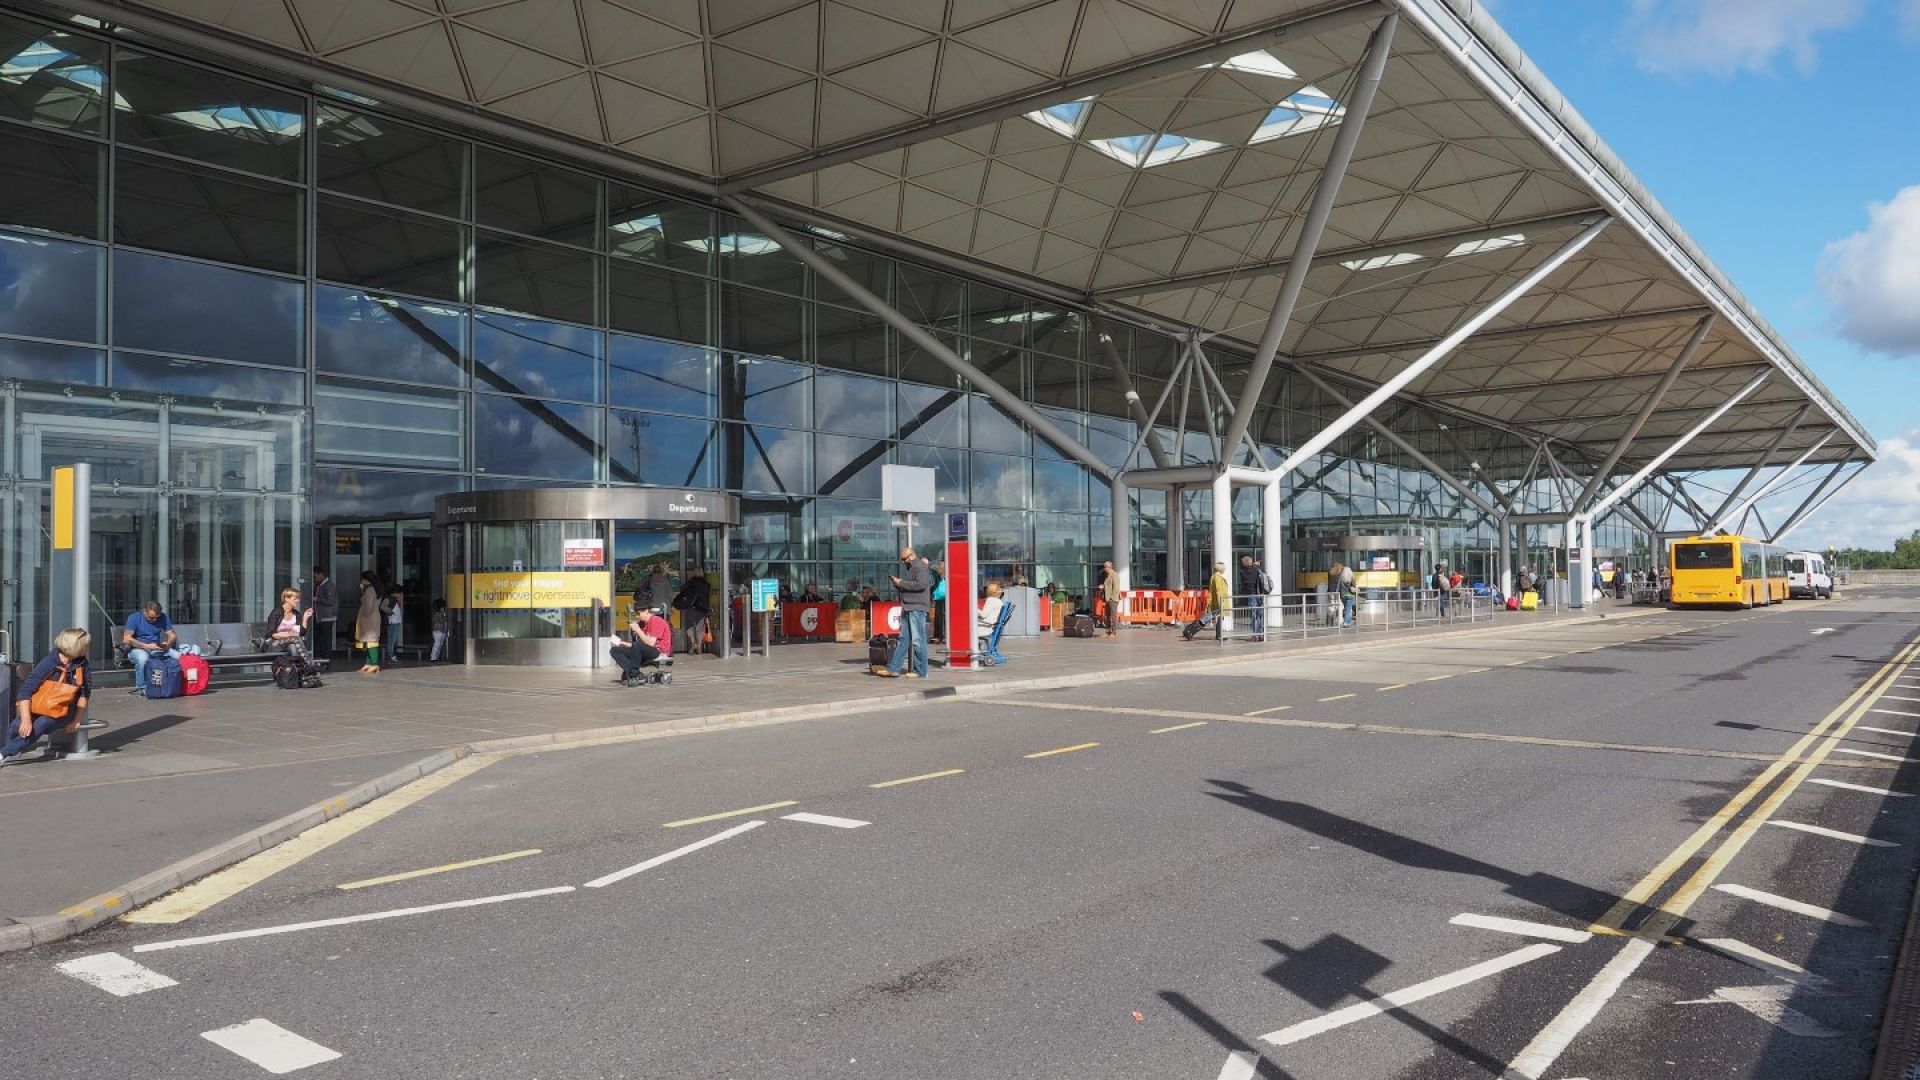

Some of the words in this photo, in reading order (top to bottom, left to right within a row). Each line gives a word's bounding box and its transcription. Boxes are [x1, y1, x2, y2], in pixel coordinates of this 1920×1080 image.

[669, 503, 707, 515] Departures
[483, 590, 530, 603] rightmove
[534, 590, 585, 600] overseas
